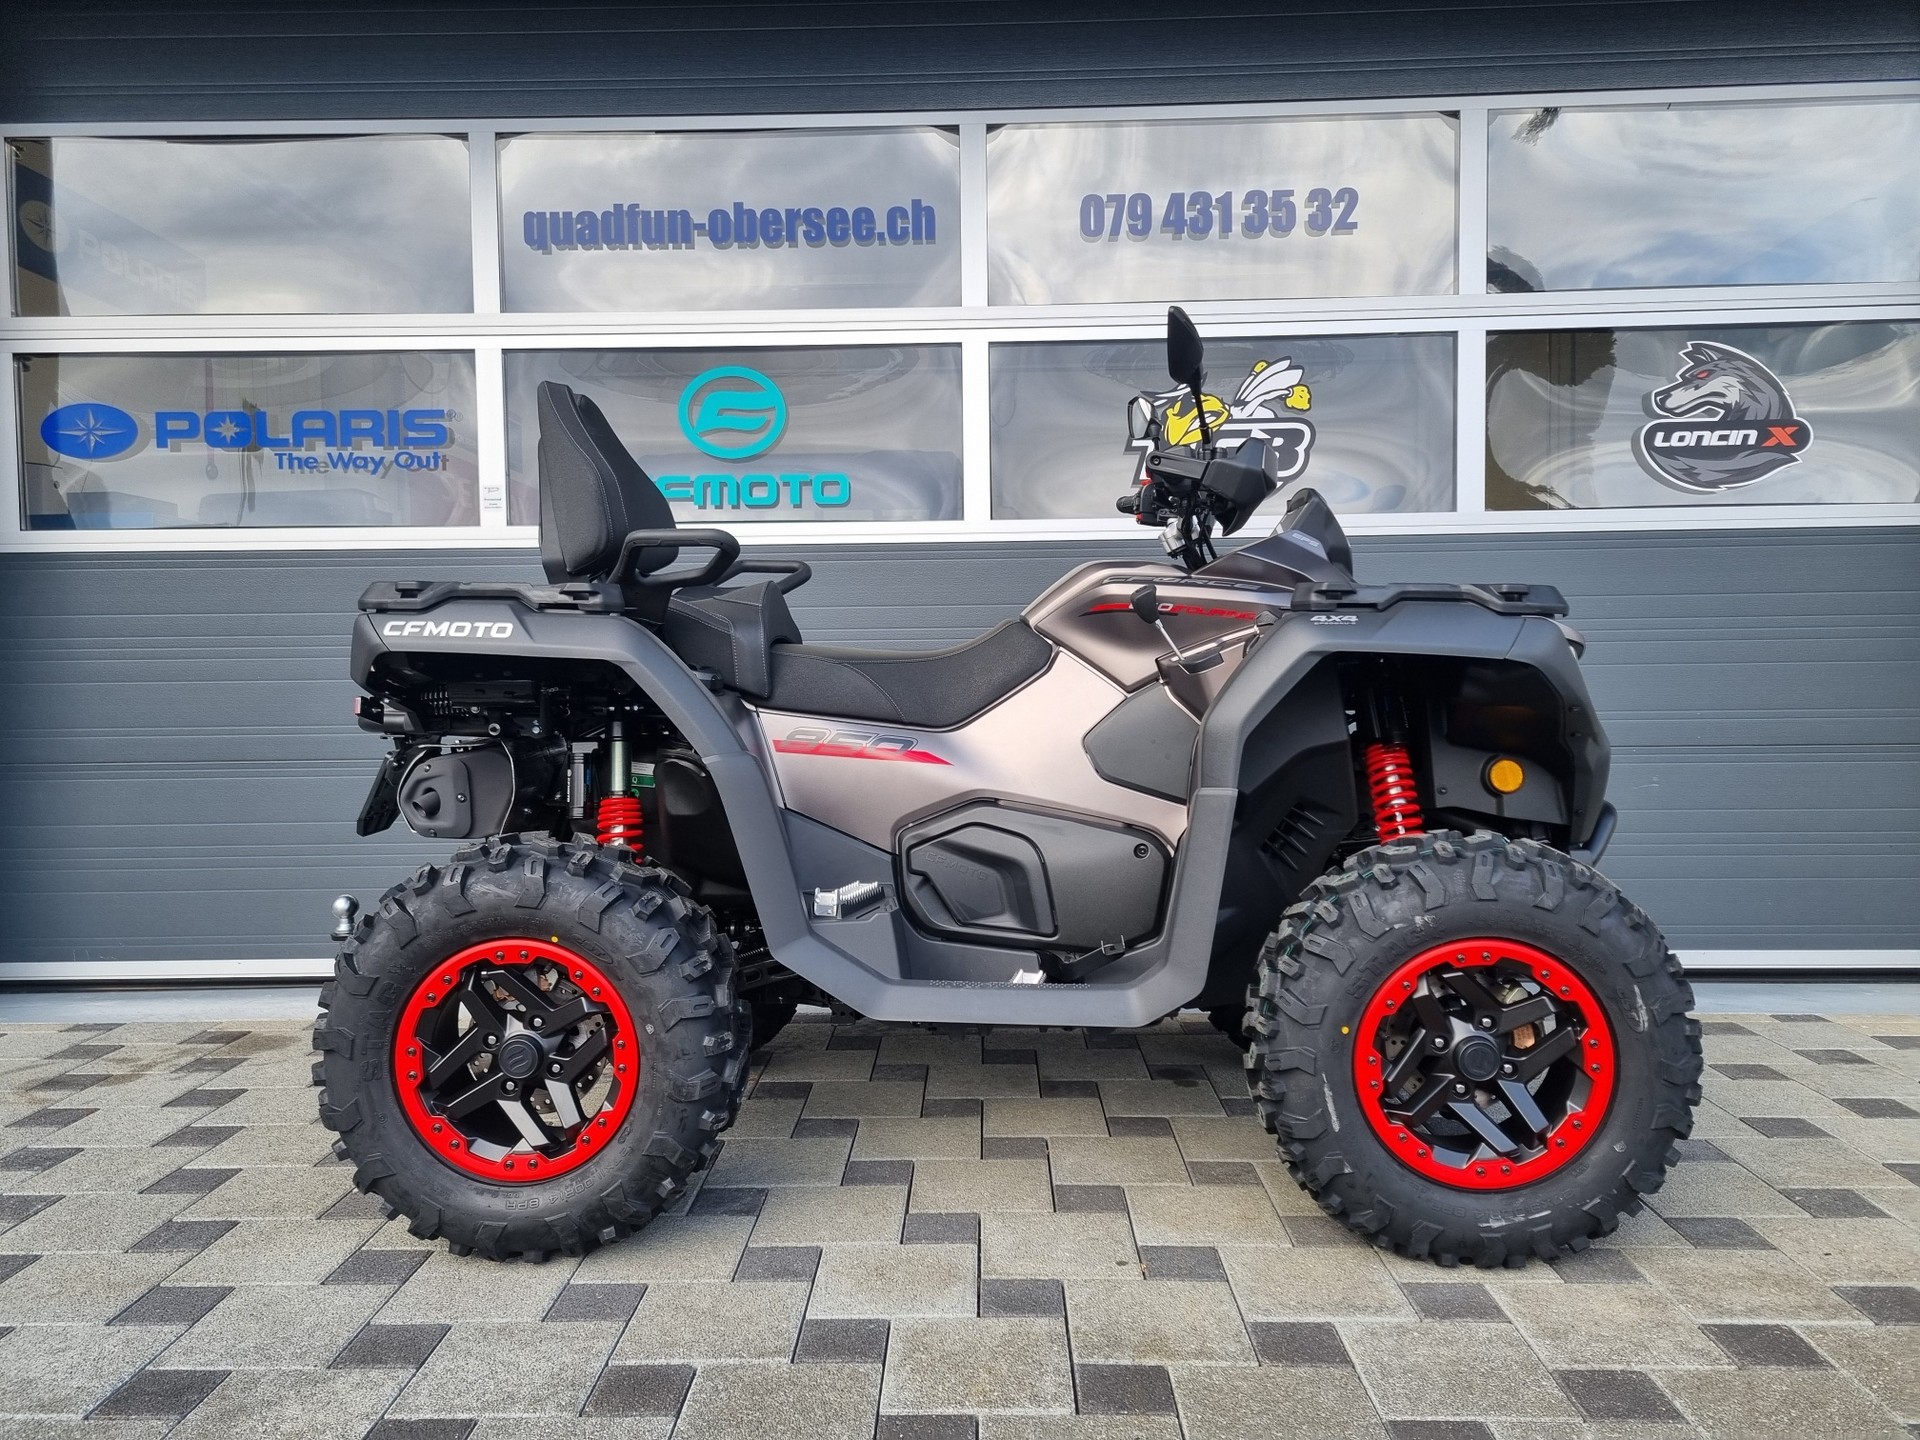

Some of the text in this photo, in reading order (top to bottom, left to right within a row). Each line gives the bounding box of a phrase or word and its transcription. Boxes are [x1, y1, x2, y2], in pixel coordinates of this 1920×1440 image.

[523, 199, 936, 252] quadfun-obersee.ch
[1079, 187, 1359, 240] 079 431 35 32
[154, 409, 449, 449] POLARIS
[1653, 426, 1801, 448] LONCIN X
[274, 450, 440, 476] The Way Out
[655, 473, 850, 506] FMOTO
[1102, 575, 1262, 592] CFORCE
[1171, 603, 1257, 620] TOURING
[383, 621, 514, 639] CFMOTO
[505, 1197, 541, 1211] 8PR
